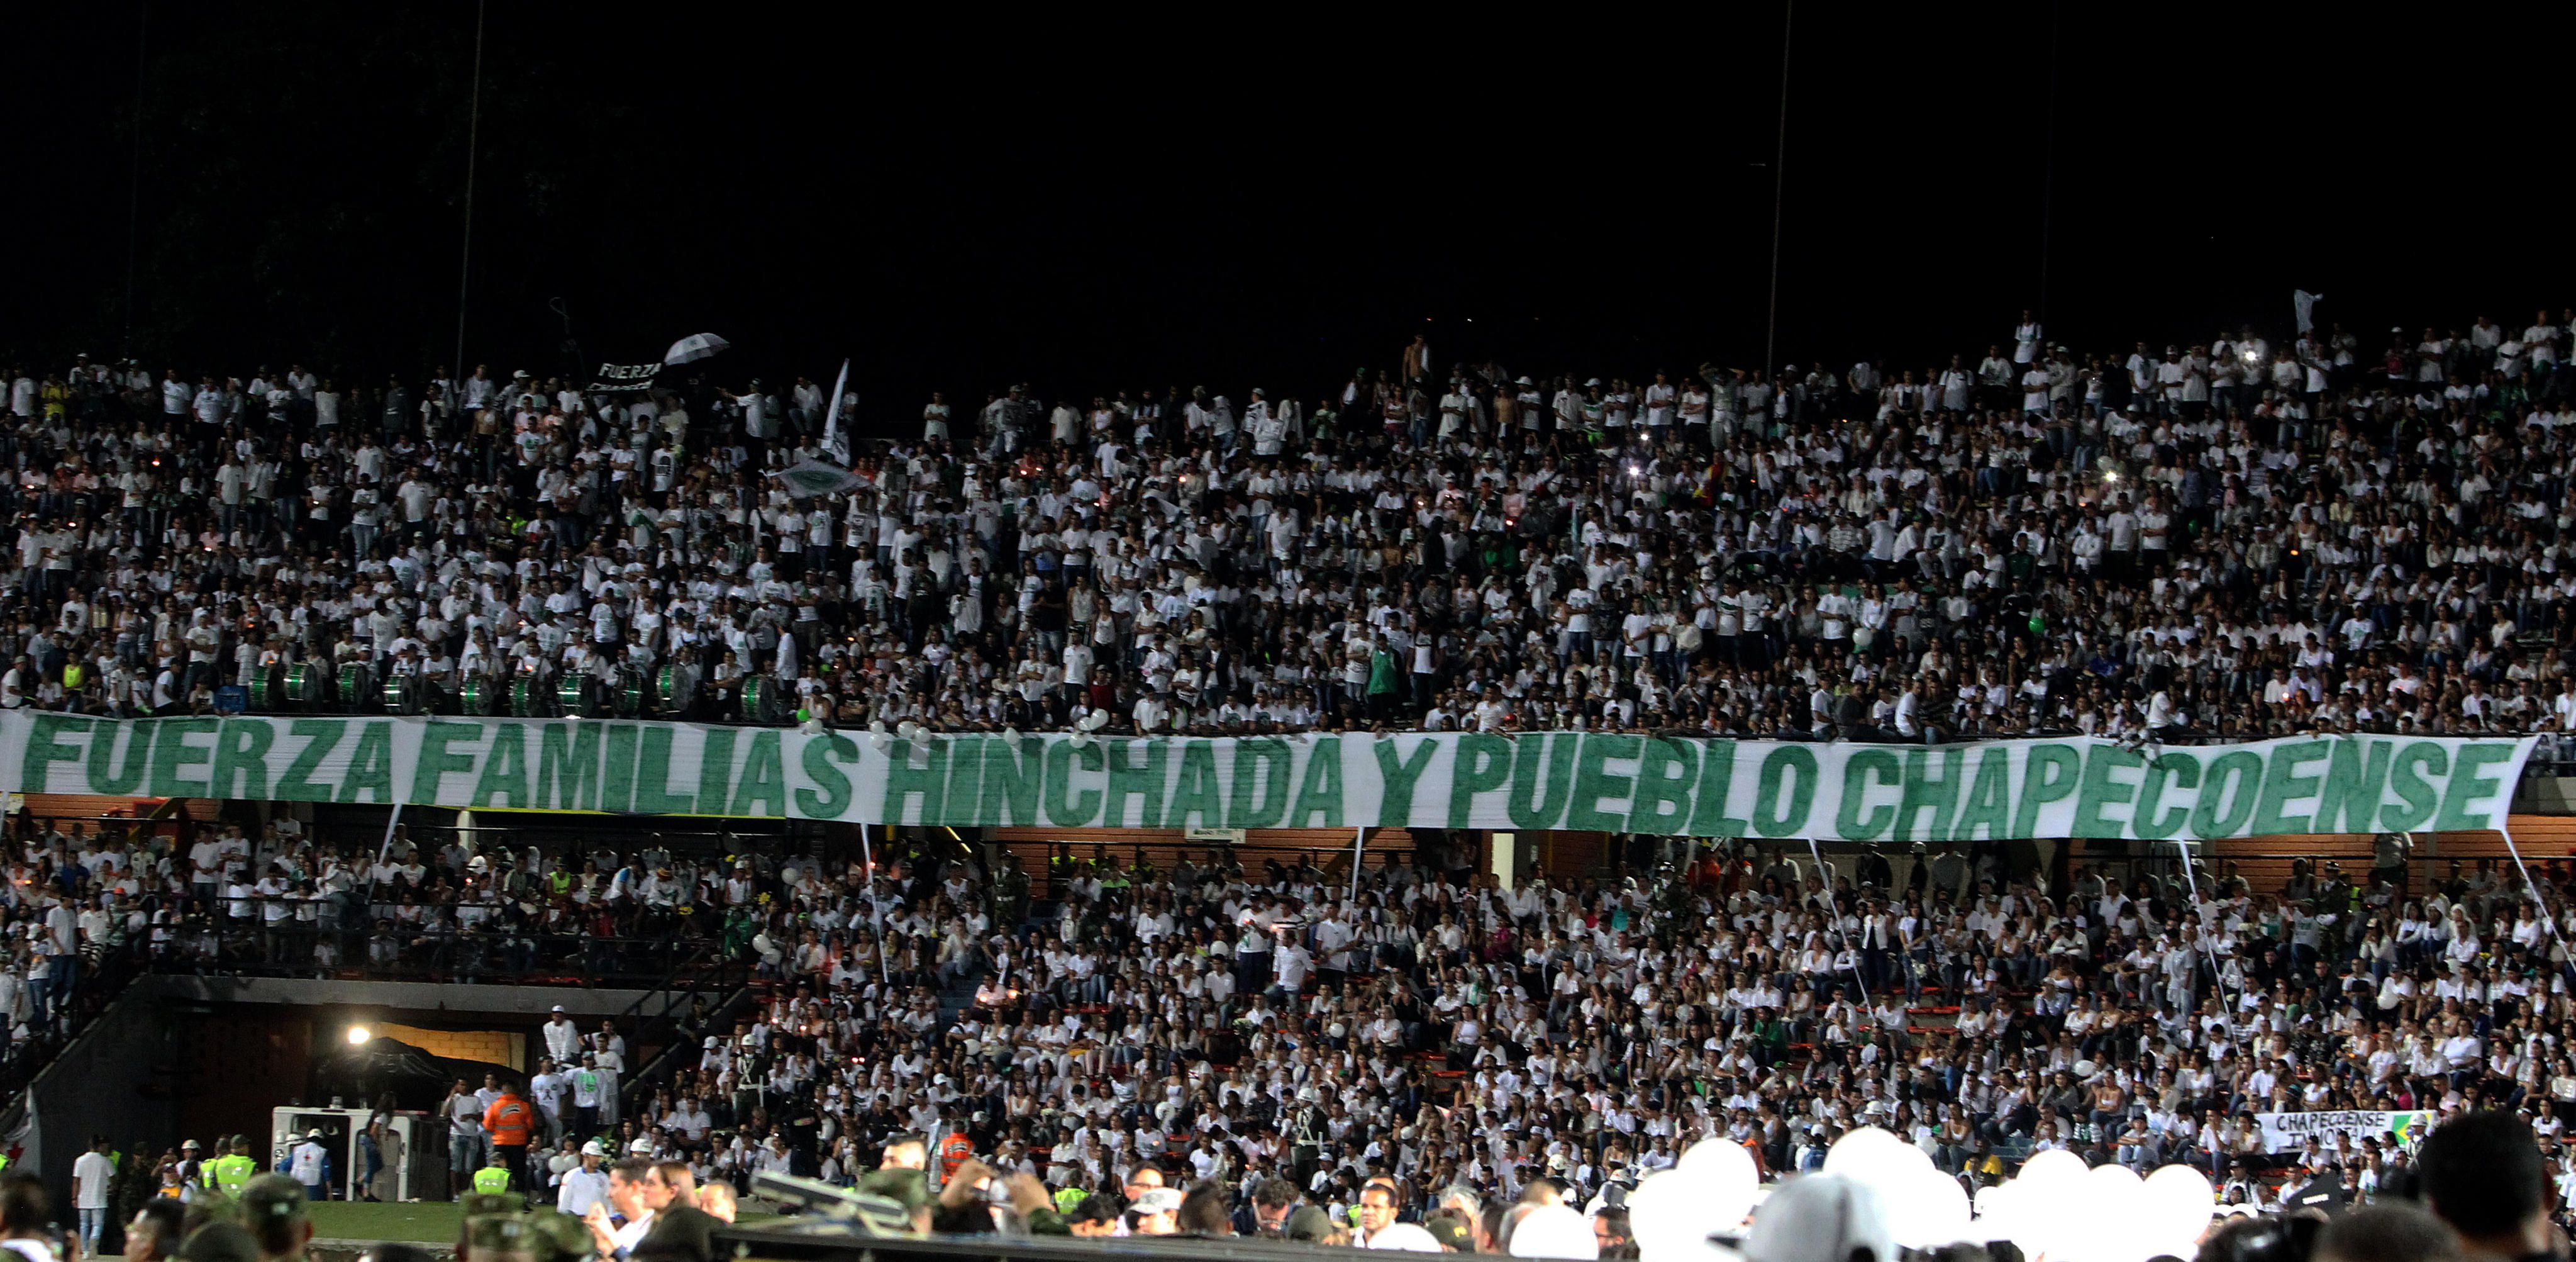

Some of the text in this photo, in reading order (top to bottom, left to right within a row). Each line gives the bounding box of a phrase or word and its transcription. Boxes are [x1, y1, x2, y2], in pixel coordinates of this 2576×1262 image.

[20, 714, 2517, 842] FUERZA FAMILIAS HINCHADA Y PUEBLO CHAPECOENSE
